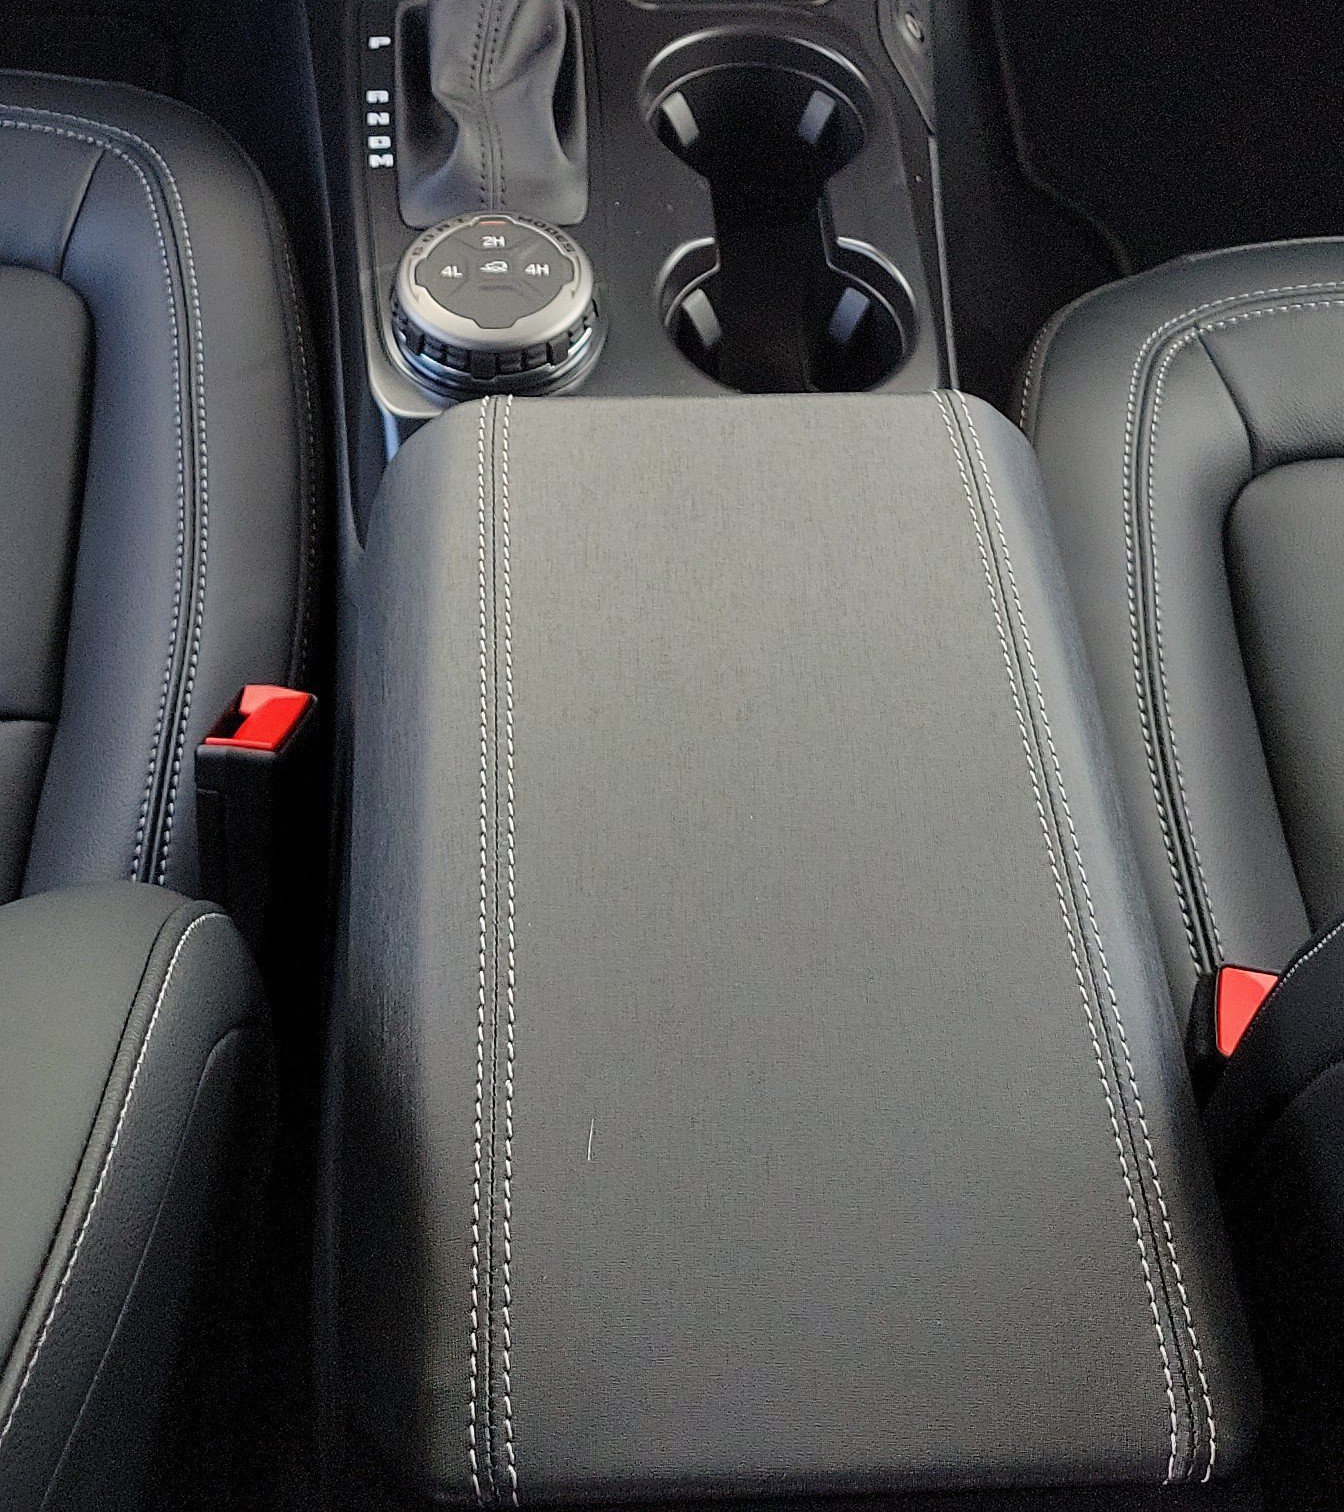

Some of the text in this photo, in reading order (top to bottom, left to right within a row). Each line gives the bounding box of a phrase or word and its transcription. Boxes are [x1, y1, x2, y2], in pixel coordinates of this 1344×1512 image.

[369, 36, 391, 49] P
[366, 112, 389, 126] N
[369, 154, 394, 168] M
[481, 236, 505, 248] 2H
[440, 265, 463, 278] 4L
[524, 264, 549, 276] 4H
